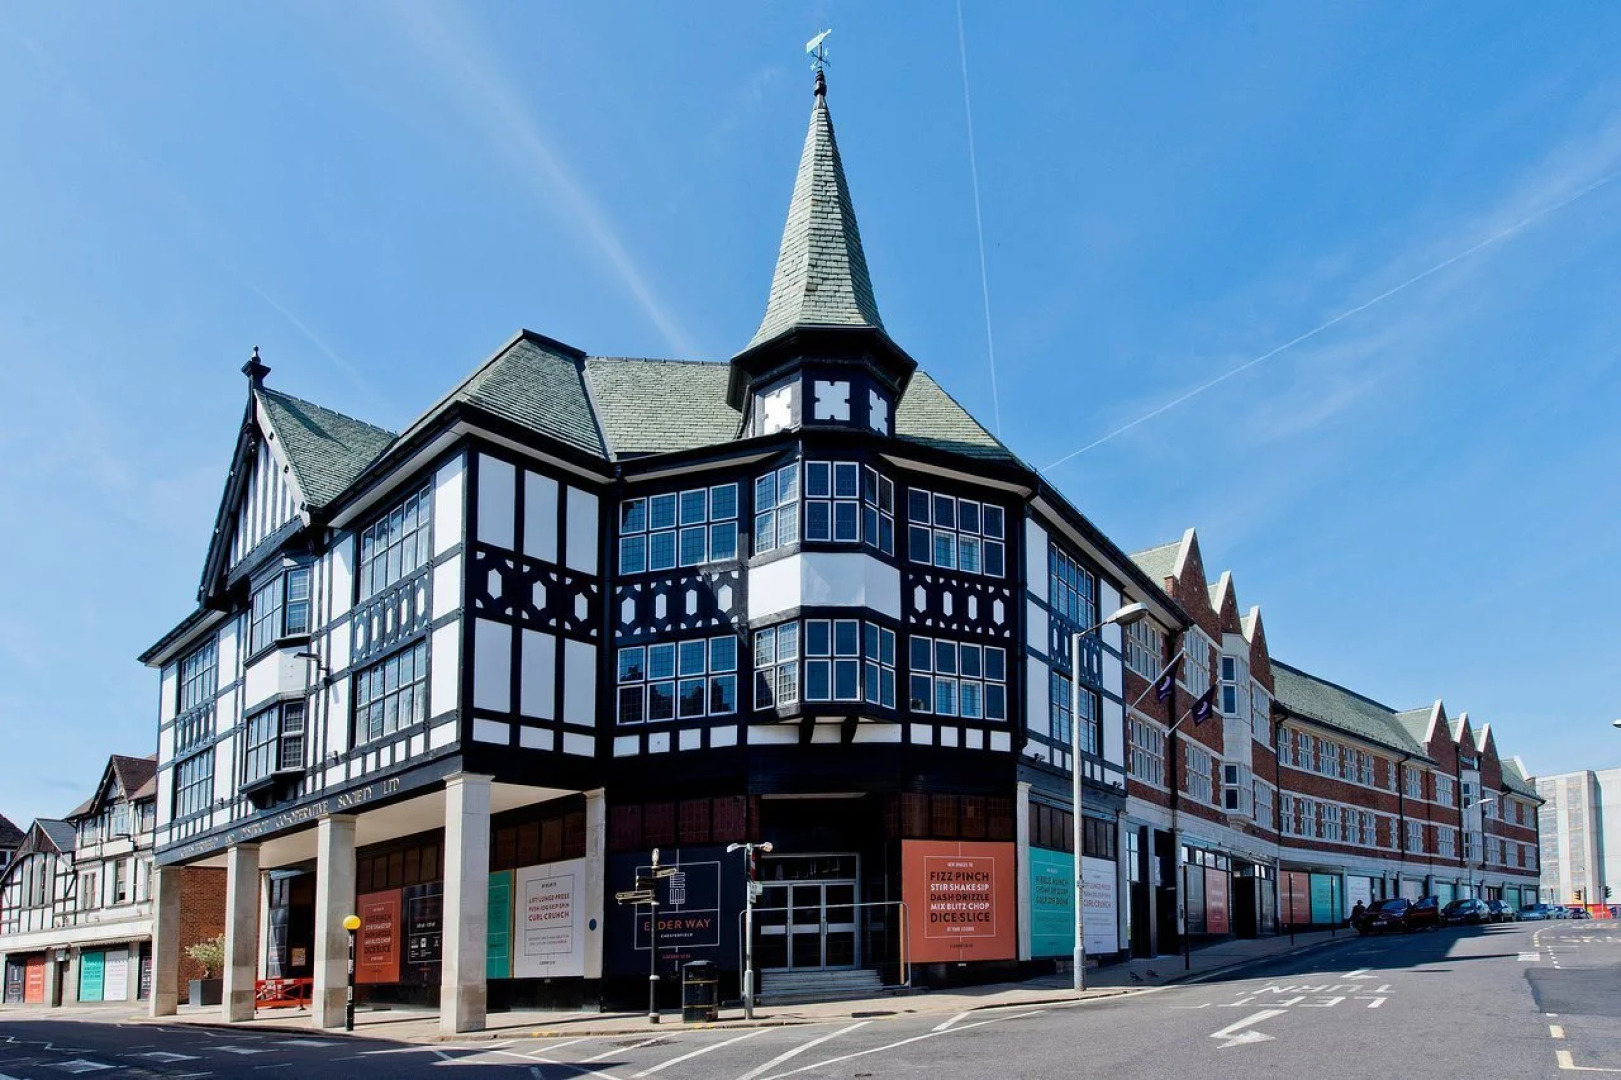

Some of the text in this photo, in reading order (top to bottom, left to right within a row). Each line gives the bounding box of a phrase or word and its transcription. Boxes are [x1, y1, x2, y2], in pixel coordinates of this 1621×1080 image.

[337, 785, 373, 808] SOCIETY
[383, 777, 400, 795] LTD
[930, 871, 989, 882] FIZZ PINCH
[930, 883, 990, 891] STIR SHAKE SIP
[930, 893, 990, 901] DASH DRIZZLE
[930, 902, 990, 911] MIX BLITZ CHOP
[528, 911, 569, 922] CURL CRUNCH
[930, 912, 991, 923] DICE SLICE
[643, 918, 711, 931] EDER WAY
[1251, 982, 1396, 993] TURN
